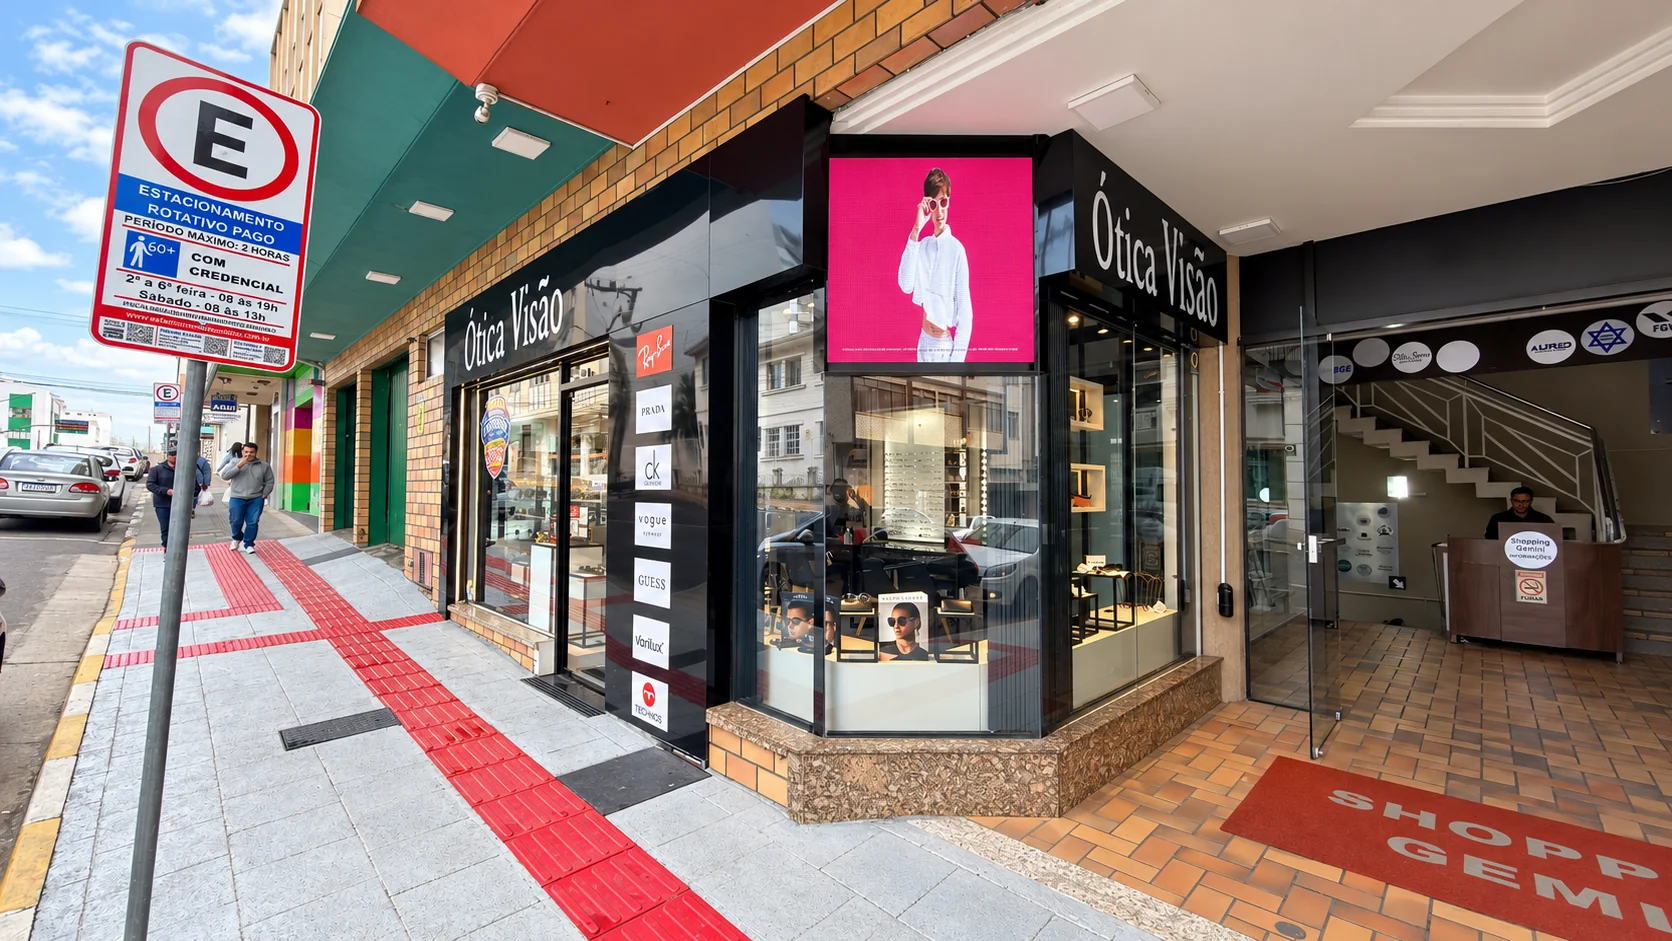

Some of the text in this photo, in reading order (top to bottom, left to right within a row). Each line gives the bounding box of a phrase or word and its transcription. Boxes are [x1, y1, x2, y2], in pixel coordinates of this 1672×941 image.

[193, 100, 253, 180] E
[139, 184, 285, 232] ESTACIONAMENTO
[148, 203, 275, 245] ROTATIVO PAGO
[147, 241, 176, 255] 60+
[241, 243, 249, 253] 2
[251, 246, 290, 263] HORAS
[1092, 170, 1218, 327] Ótica Visão
[191, 252, 226, 268] COM
[189, 266, 284, 295] CREDENCIAL
[144, 279, 153, 288] a
[176, 285, 206, 299] feira
[218, 293, 234, 304] 08
[257, 301, 278, 313] 19h
[204, 302, 220, 314] 08
[244, 310, 266, 322] 13h
[464, 275, 563, 371] Ótica Visão
[163, 388, 172, 398] E
[641, 404, 665, 417] PRADA
[638, 515, 667, 528] vogue
[1510, 537, 1550, 547] Shopping
[1515, 544, 1546, 553] Gemini
[638, 574, 666, 591] GUESS
[1327, 789, 1659, 881] SHOPP
